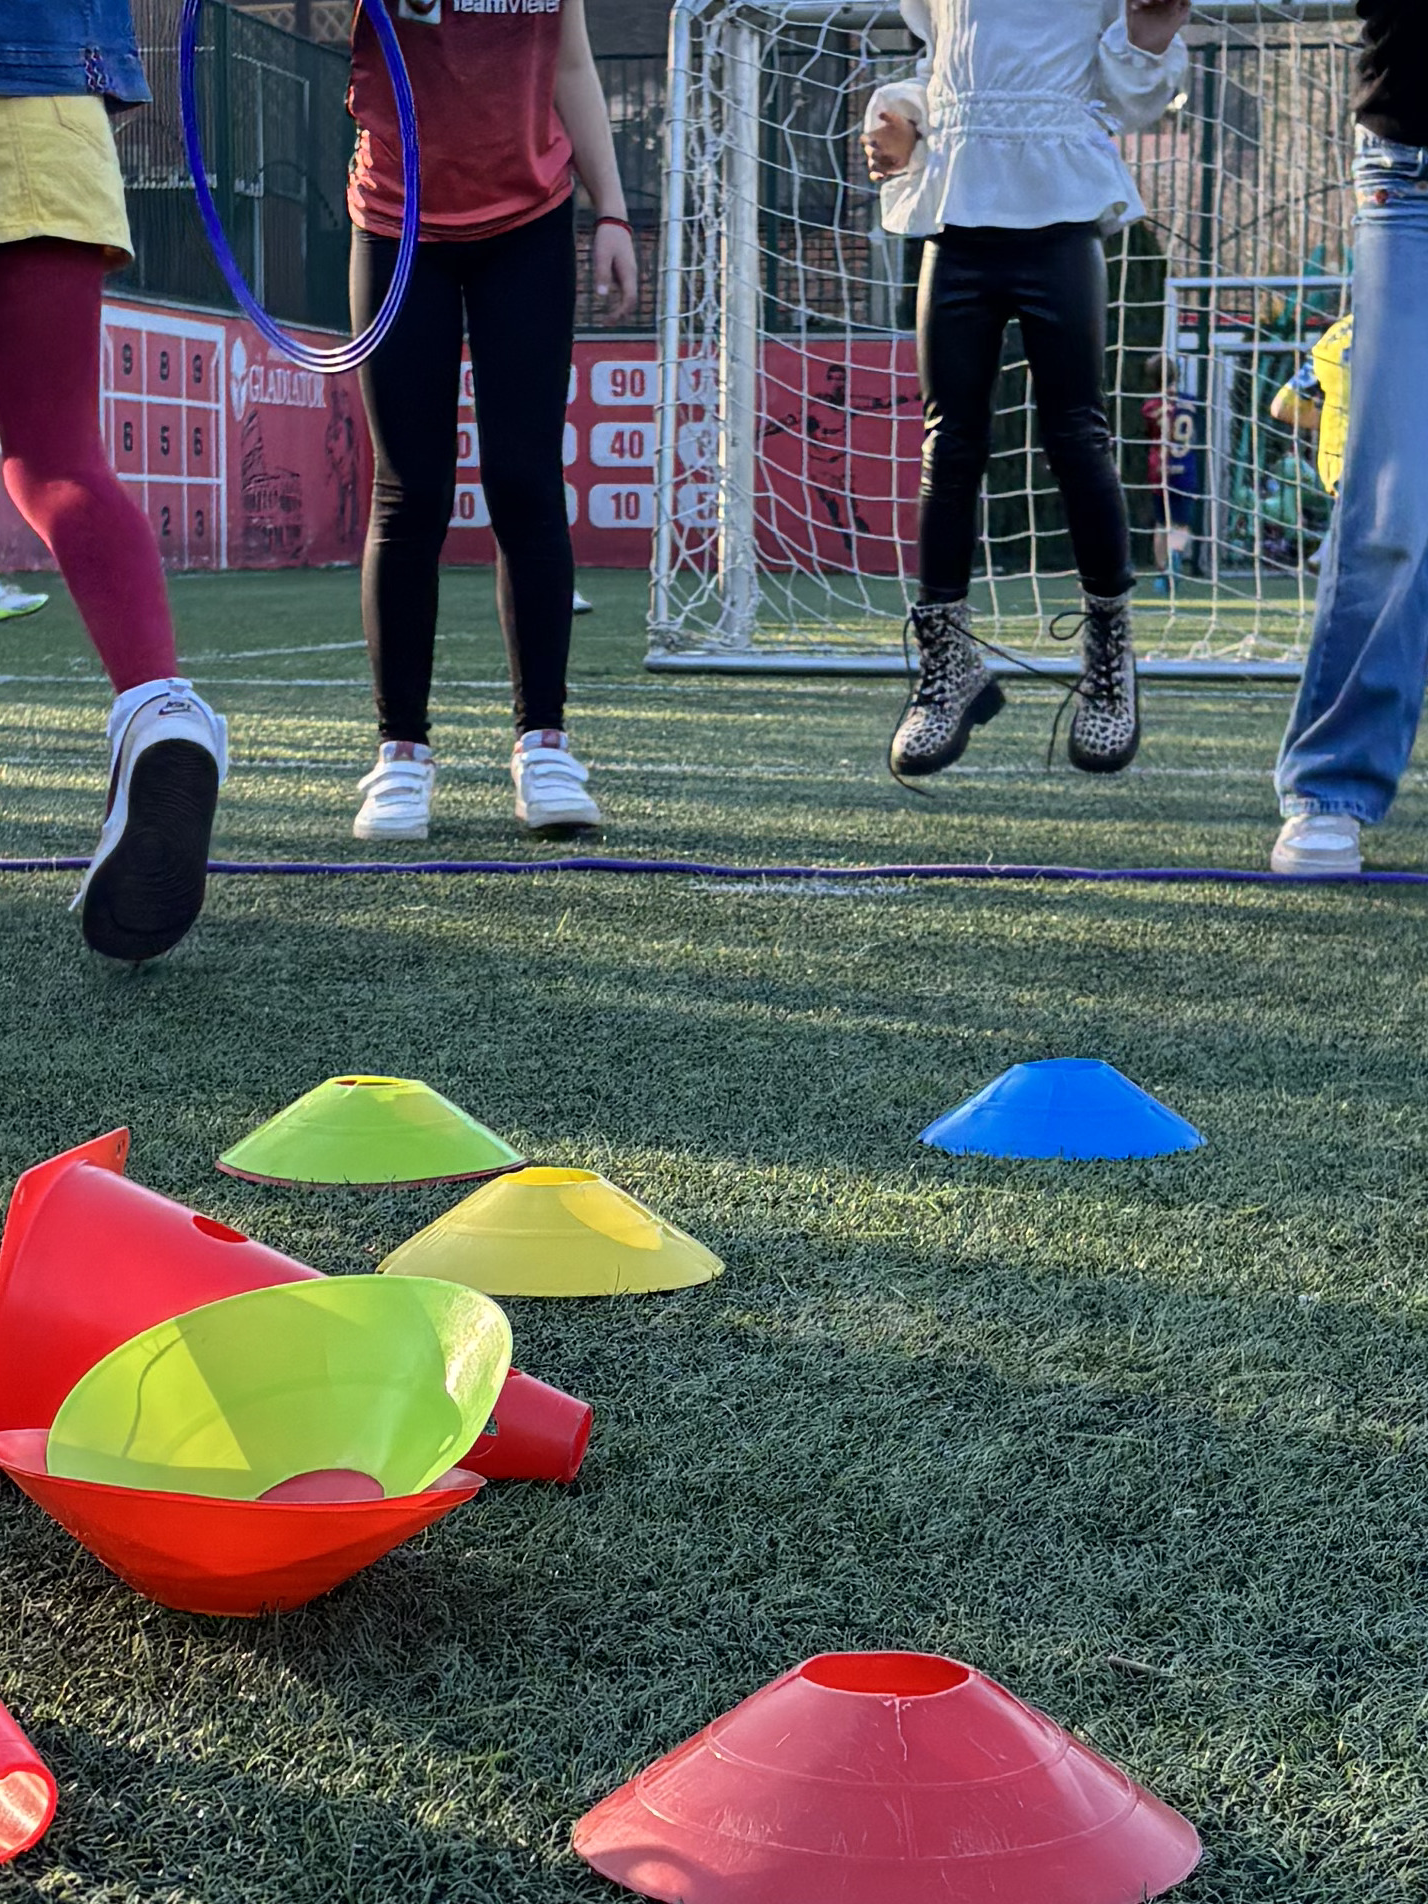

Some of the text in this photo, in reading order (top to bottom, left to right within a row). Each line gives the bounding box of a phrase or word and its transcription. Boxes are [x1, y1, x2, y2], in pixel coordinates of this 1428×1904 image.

[610, 368, 645, 397] 90
[160, 426, 170, 455] 5
[609, 429, 645, 459] 40
[610, 492, 641, 520] 10
[161, 506, 171, 536] 2
